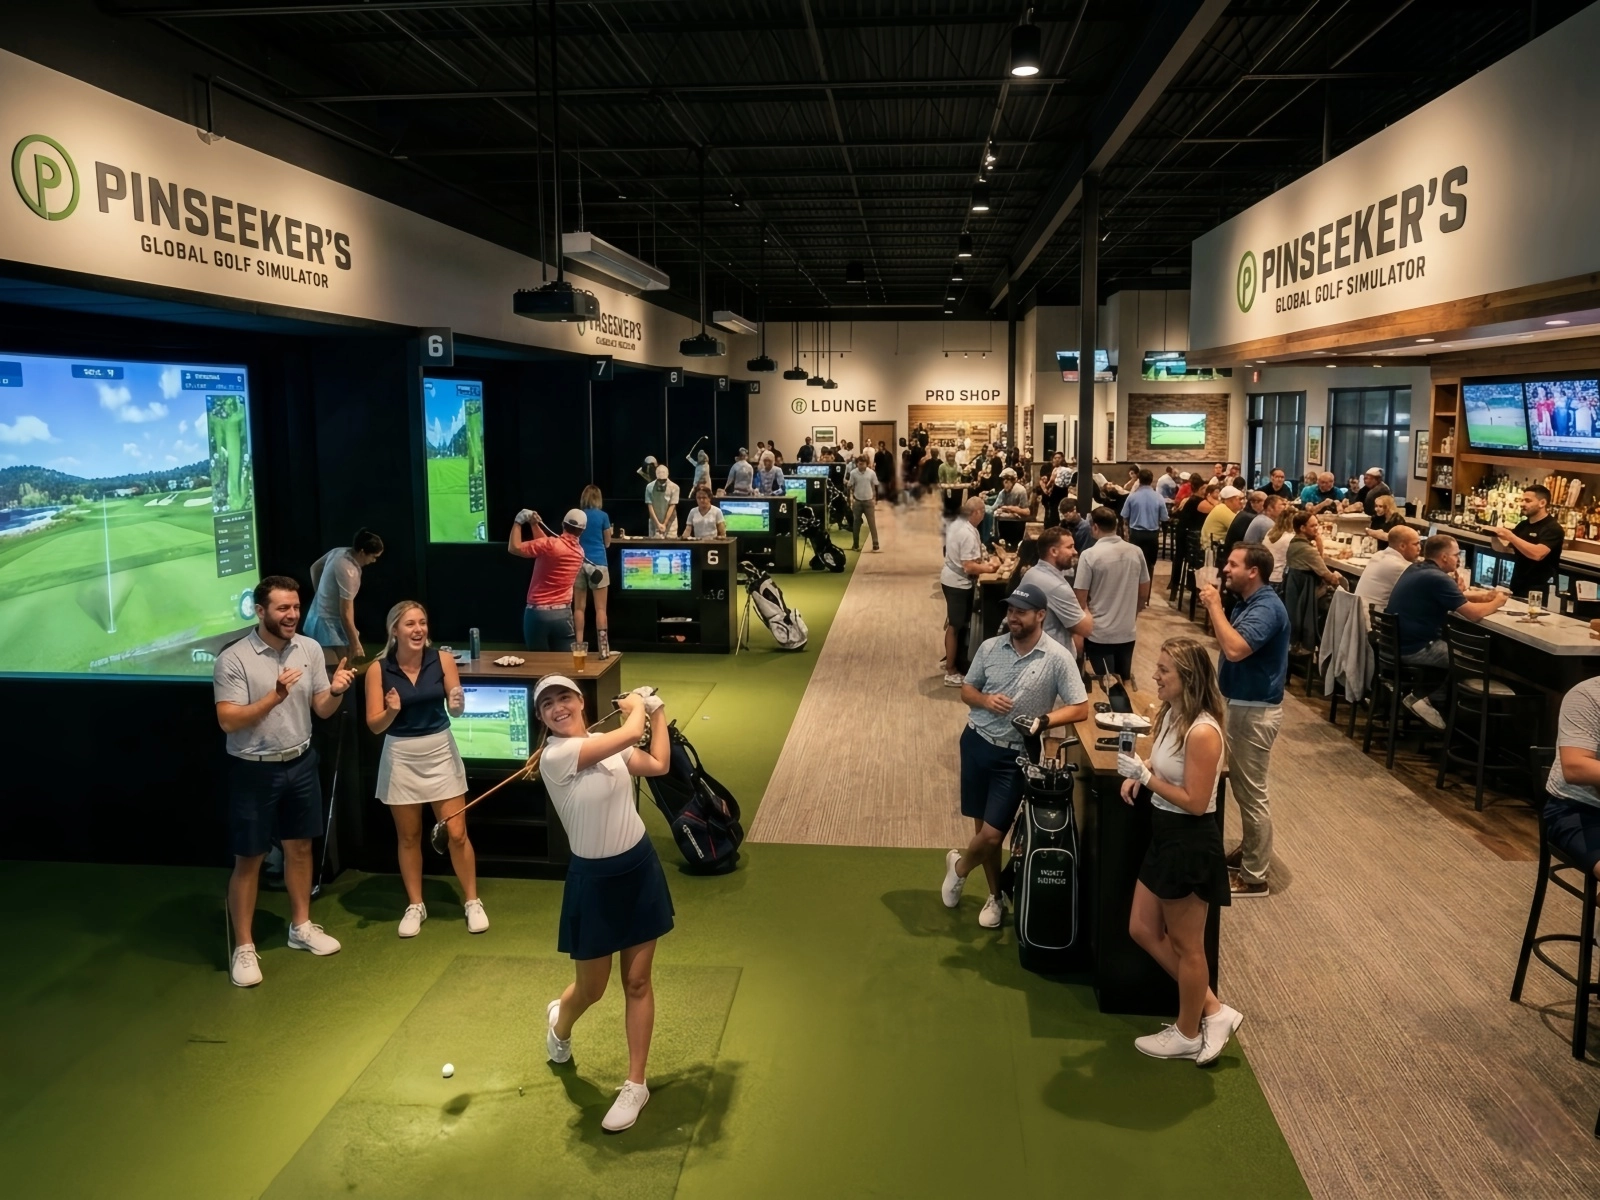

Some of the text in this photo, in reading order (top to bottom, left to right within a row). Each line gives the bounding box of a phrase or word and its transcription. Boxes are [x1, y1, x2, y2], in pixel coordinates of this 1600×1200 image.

[95, 161, 352, 271] PINSEEKER'S
[1261, 165, 1469, 293] PINSEEKER'S
[140, 234, 330, 290] GLOBAL GOLF SIMULATOR
[1275, 255, 1426, 314] GLOBAL GOLF SIMULATOR
[427, 334, 444, 357] 6
[596, 360, 607, 376] 7
[811, 399, 877, 413] LOUNGE
[925, 389, 1001, 401] PRO SHOP
[707, 549, 719, 565] 6
